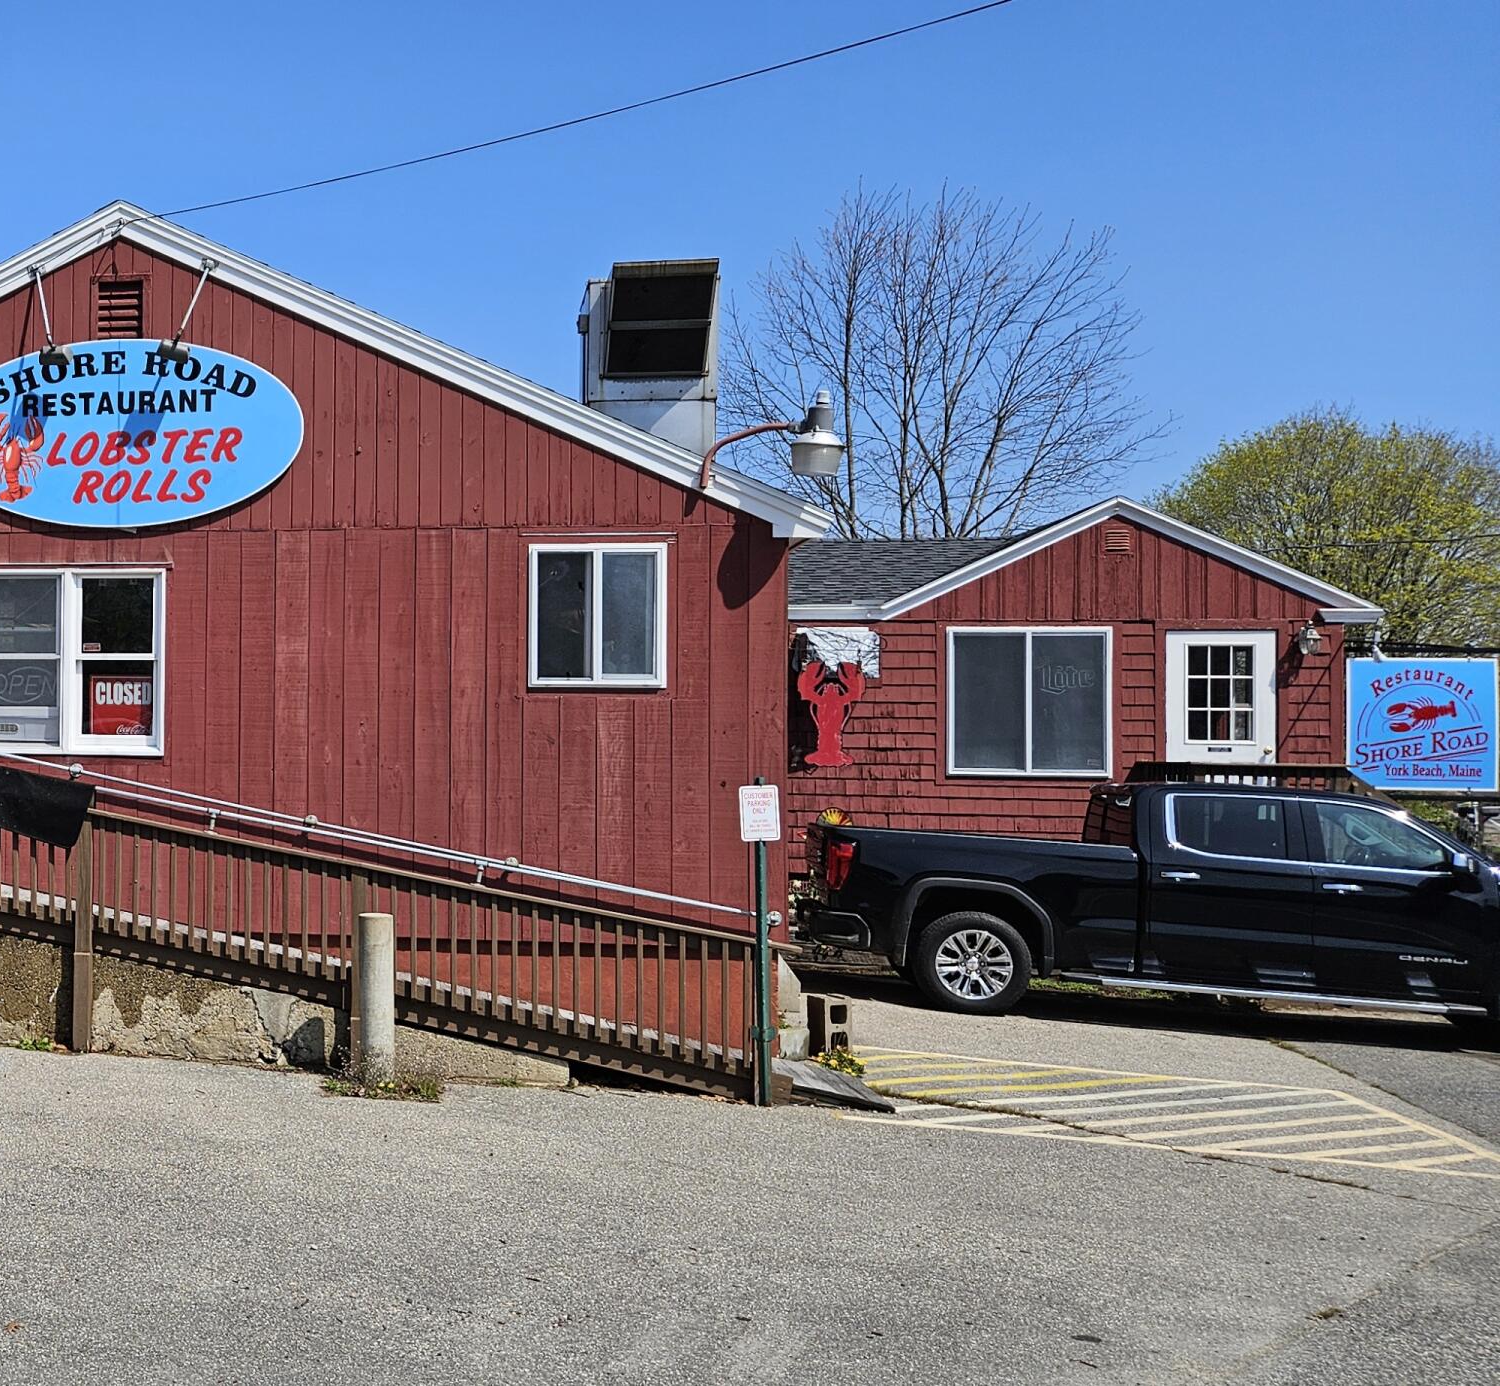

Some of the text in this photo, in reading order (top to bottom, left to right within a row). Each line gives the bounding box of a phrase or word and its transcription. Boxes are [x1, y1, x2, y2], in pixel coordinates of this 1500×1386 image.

[142, 350, 257, 399] ROAD
[21, 388, 217, 418] RESTAURANT
[46, 426, 244, 468] LOBSTER
[72, 468, 213, 505] ROLLS
[95, 681, 152, 706] CLOSED
[1370, 669, 1474, 700] Restaurant
[1355, 731, 1488, 765] SHORE ROAD
[1384, 763, 1482, 779] York Beach, Maine
[1398, 954, 1469, 965] DENALI
